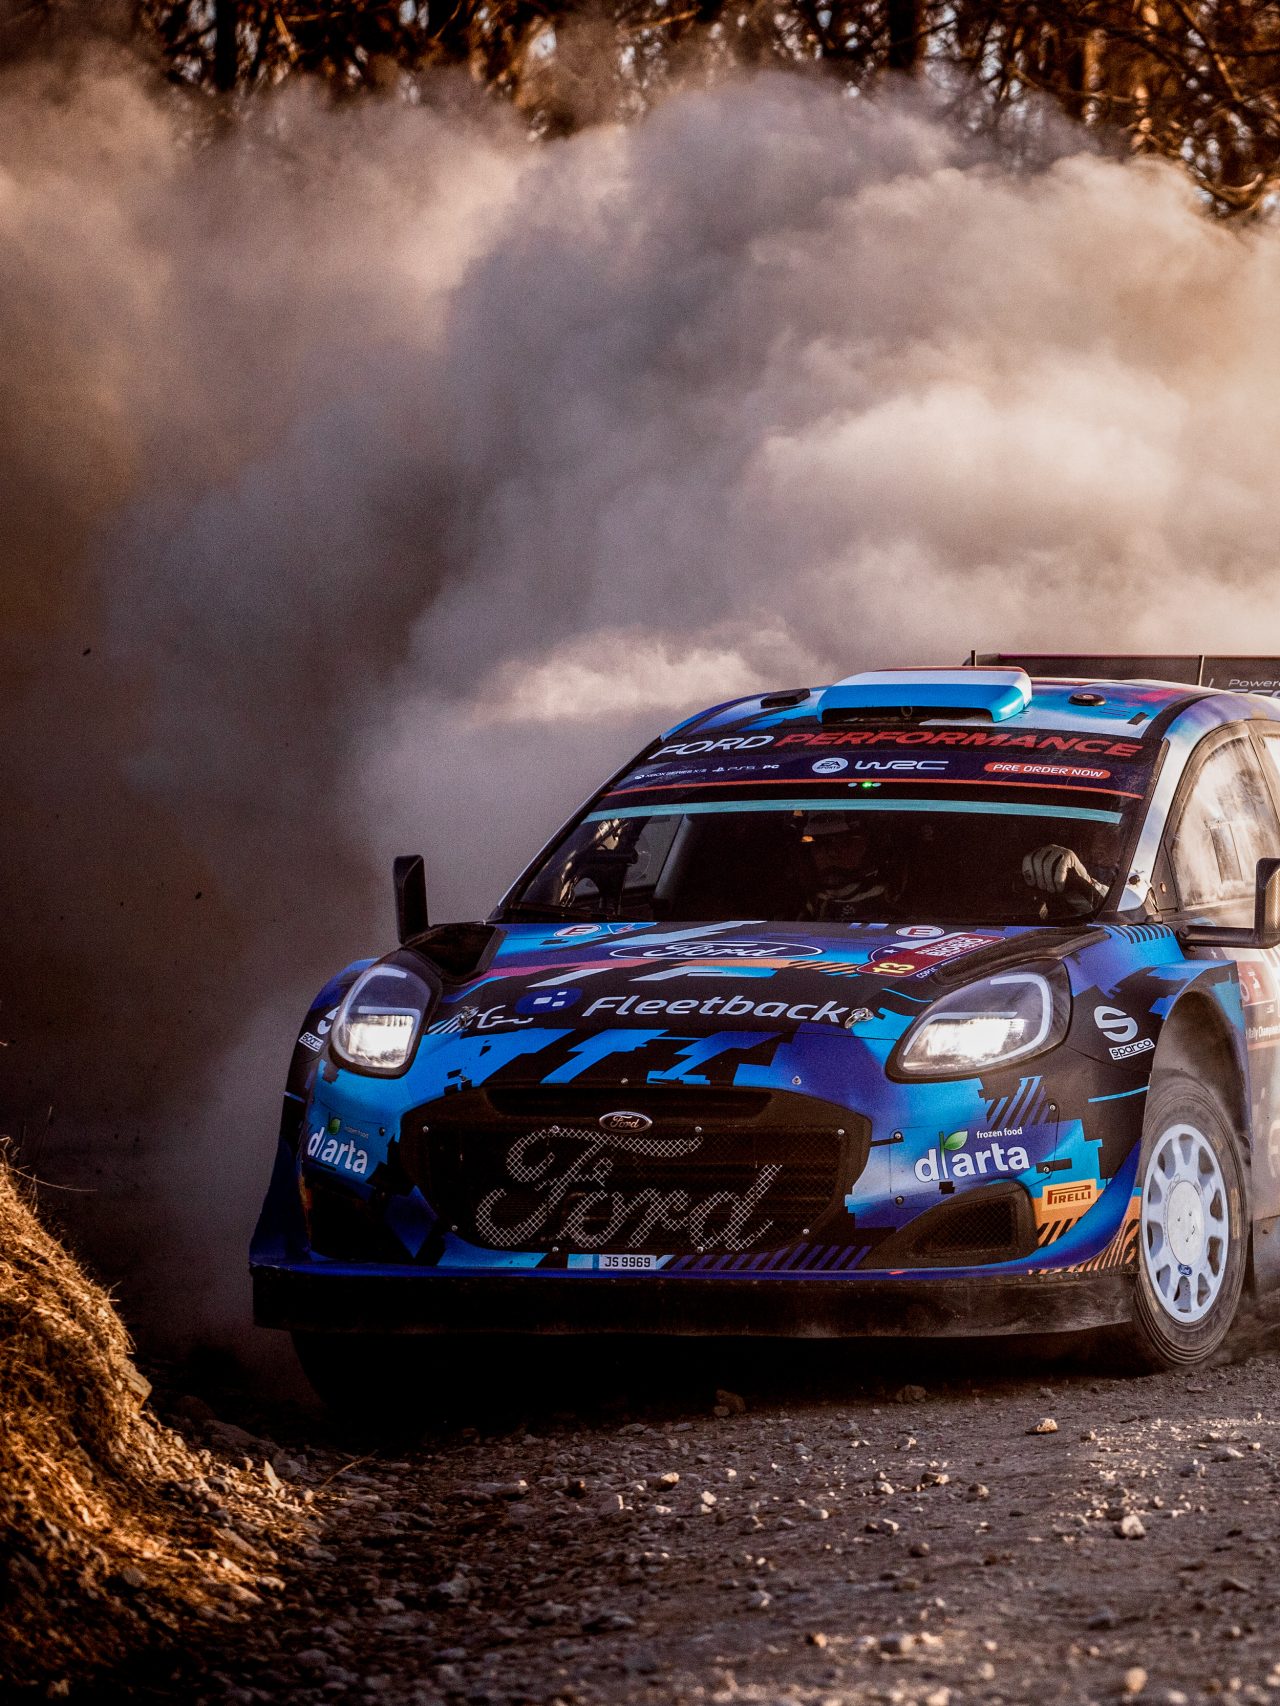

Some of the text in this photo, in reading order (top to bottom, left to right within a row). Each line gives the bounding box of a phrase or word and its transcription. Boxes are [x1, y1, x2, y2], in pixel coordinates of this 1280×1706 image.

[647, 730, 1144, 760] FORD PERFORMANCE
[854, 760, 950, 770] WRC
[992, 764, 1104, 778] PRE ORDER NOW
[642, 943, 788, 957] Ford
[872, 962, 915, 975] 13
[581, 995, 851, 1023] Fleetback
[1111, 1040, 1152, 1058] sparco
[609, 1116, 641, 1129] Ford
[976, 1127, 1023, 1139] frozen food
[475, 1127, 784, 1252] Ford
[1046, 1184, 1092, 1206] PIRELLI
[604, 1256, 651, 1268] JS 9969
